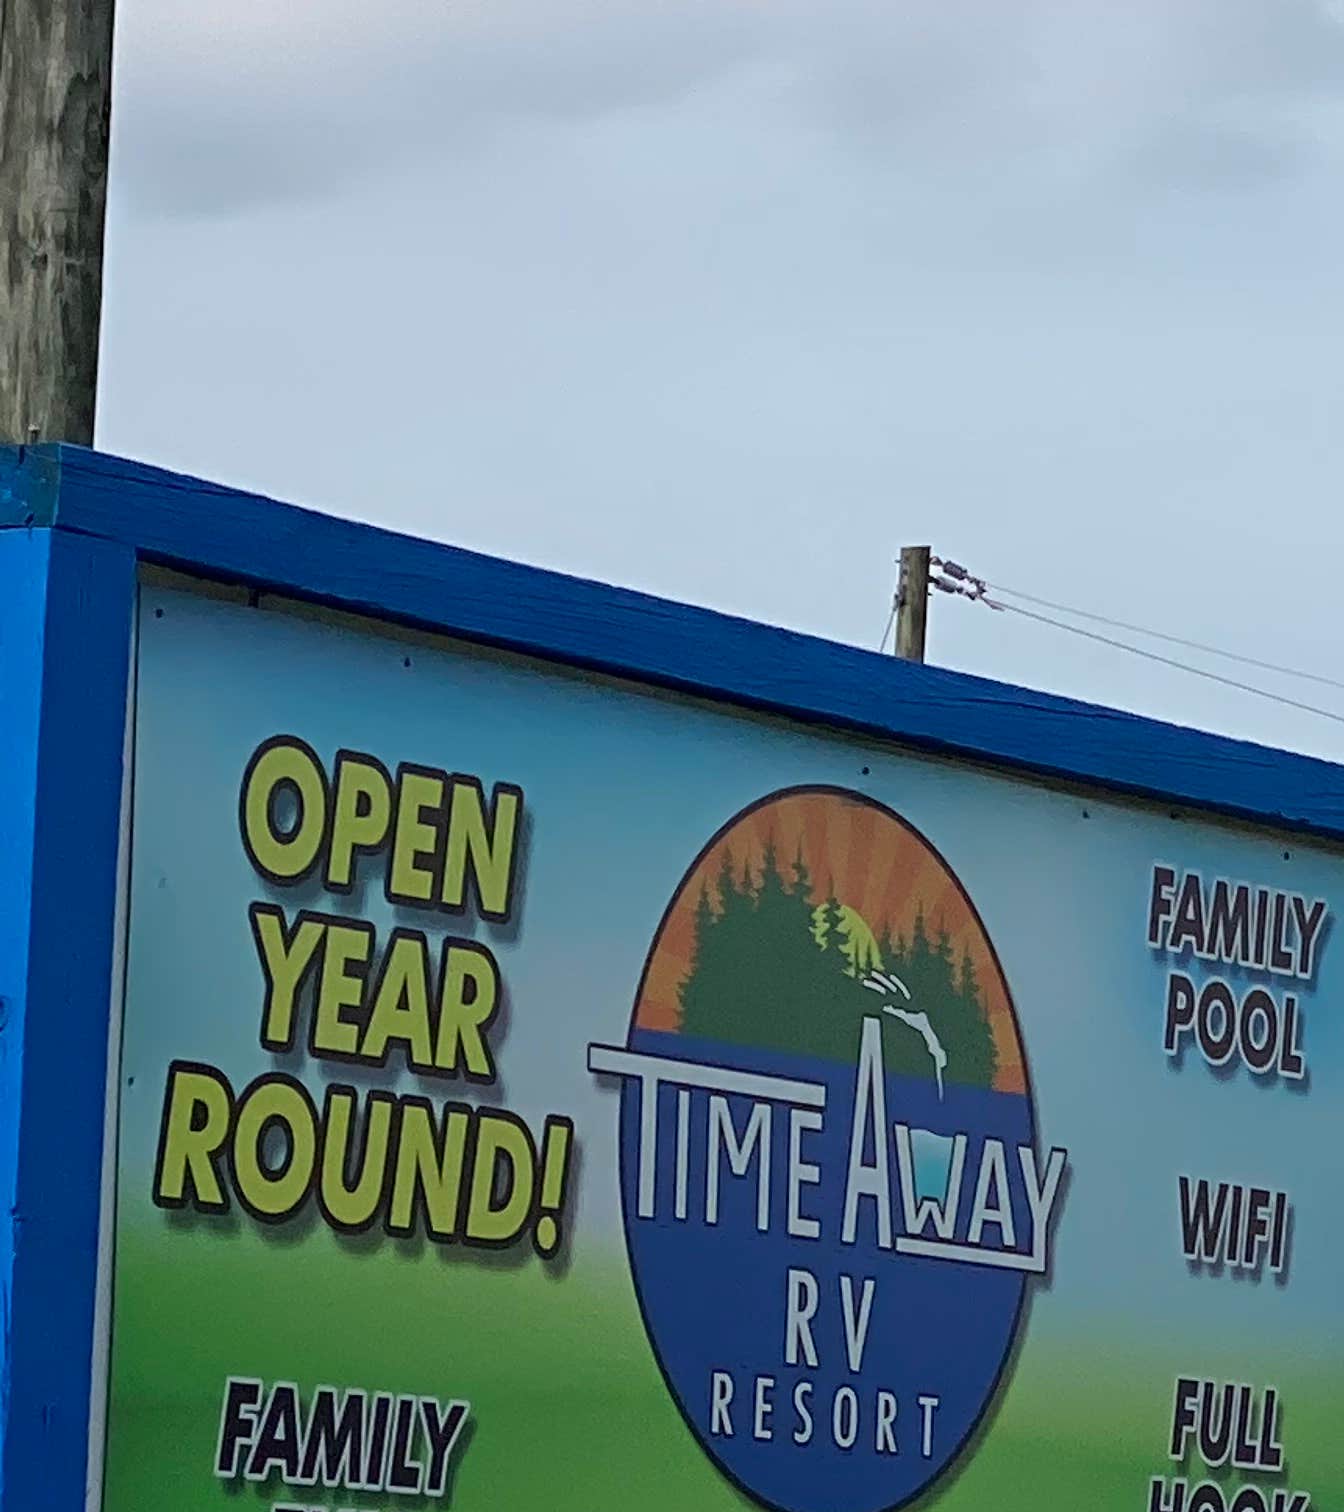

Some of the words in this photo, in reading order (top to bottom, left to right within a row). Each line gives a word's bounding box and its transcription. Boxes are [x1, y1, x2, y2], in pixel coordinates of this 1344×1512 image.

[239, 734, 524, 923] OPEN
[1147, 863, 1328, 979] FAMILY
[249, 903, 497, 1085] YEAR
[1163, 971, 1306, 1080] POOL
[153, 1060, 574, 1259] ROUND!
[588, 1042, 826, 1239] TIME
[841, 1015, 1067, 1272] AWAY
[1177, 1173, 1288, 1273] WIFI
[784, 1267, 875, 1373] RV
[214, 1375, 471, 1497] FAMILY
[710, 1371, 939, 1457] RESORT
[1169, 1377, 1284, 1472] FULL
